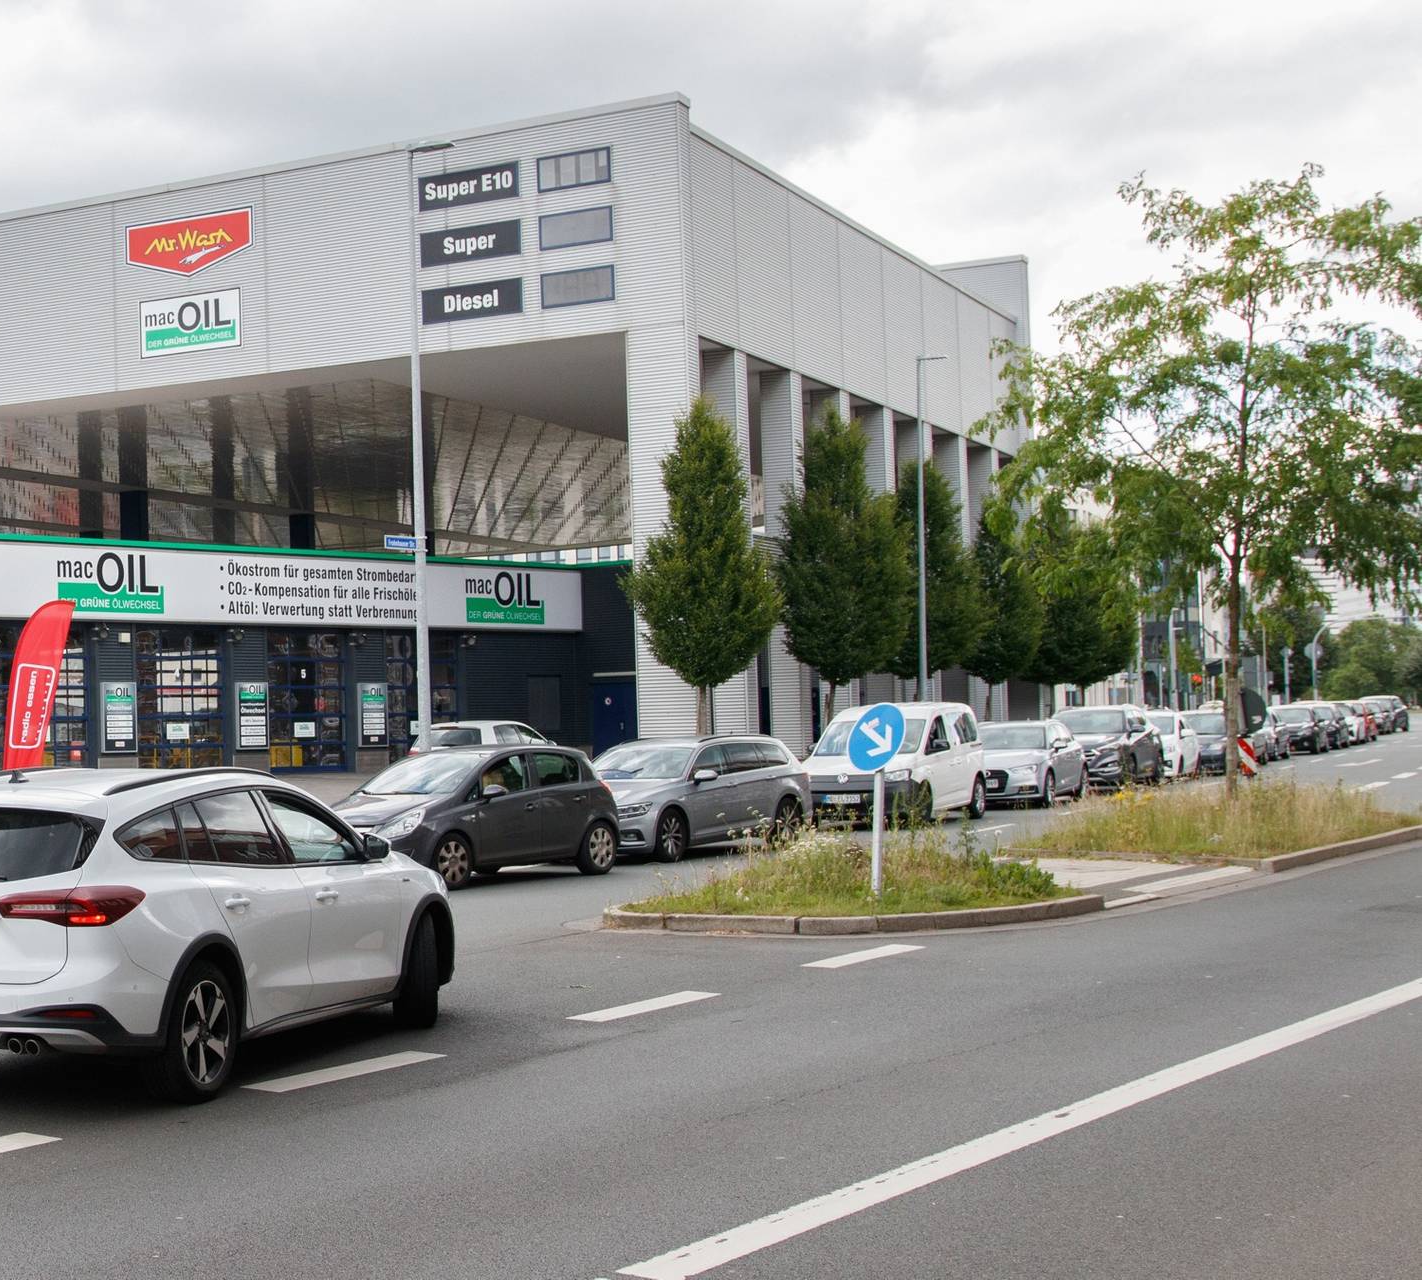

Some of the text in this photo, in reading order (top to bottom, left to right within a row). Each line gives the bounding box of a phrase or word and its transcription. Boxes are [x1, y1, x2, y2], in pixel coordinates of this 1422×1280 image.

[425, 170, 513, 201] Super E10
[443, 233, 496, 256] Super
[443, 289, 499, 313] Diesel
[145, 298, 231, 331] mac OIL
[147, 331, 233, 349] DER GRÜNE ÖLWECHSEL
[57, 552, 159, 593] mac OIL
[228, 559, 416, 583] Ökostrom für gesamten Strombedar
[333, 585, 348, 599] für
[352, 587, 370, 600] alle
[465, 571, 540, 607] mac OIL
[80, 597, 110, 608] GRÜNE
[112, 598, 161, 609] ÖLWECHSEL
[228, 601, 258, 615] Altöl:
[262, 602, 325, 620] Verwertung
[328, 604, 352, 618] statt
[468, 610, 541, 620] DER GRÜNE ÖLWECHSEL
[300, 668, 307, 679] 5
[116, 687, 130, 697] OIL
[249, 684, 264, 695] OIL
[370, 687, 384, 697] OIL
[21, 670, 38, 743] radio essen
